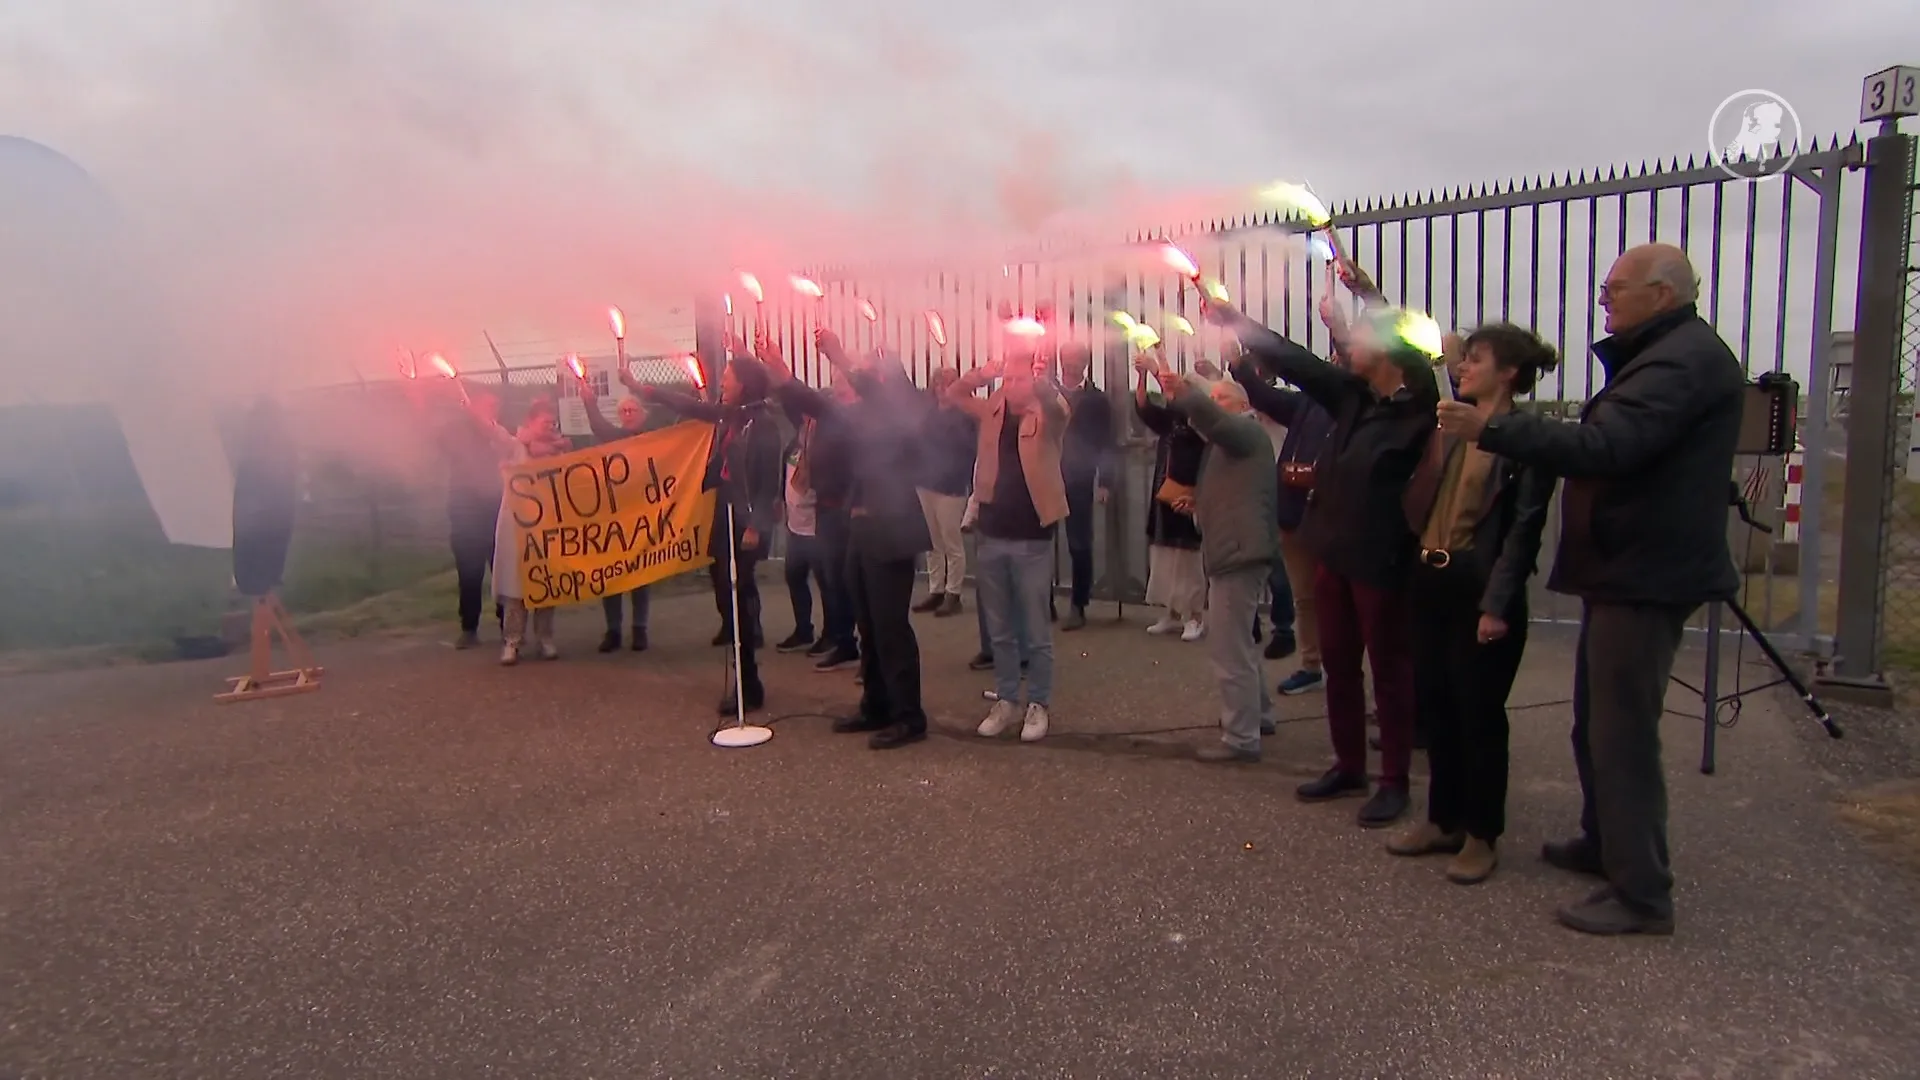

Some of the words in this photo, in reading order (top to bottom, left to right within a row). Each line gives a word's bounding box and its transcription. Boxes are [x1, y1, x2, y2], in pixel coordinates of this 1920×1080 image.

[1871, 80, 1885, 111] 3
[1903, 76, 1915, 106] 3
[509, 453, 630, 528] STOP
[645, 457, 676, 504] de
[528, 564, 585, 604] Stop
